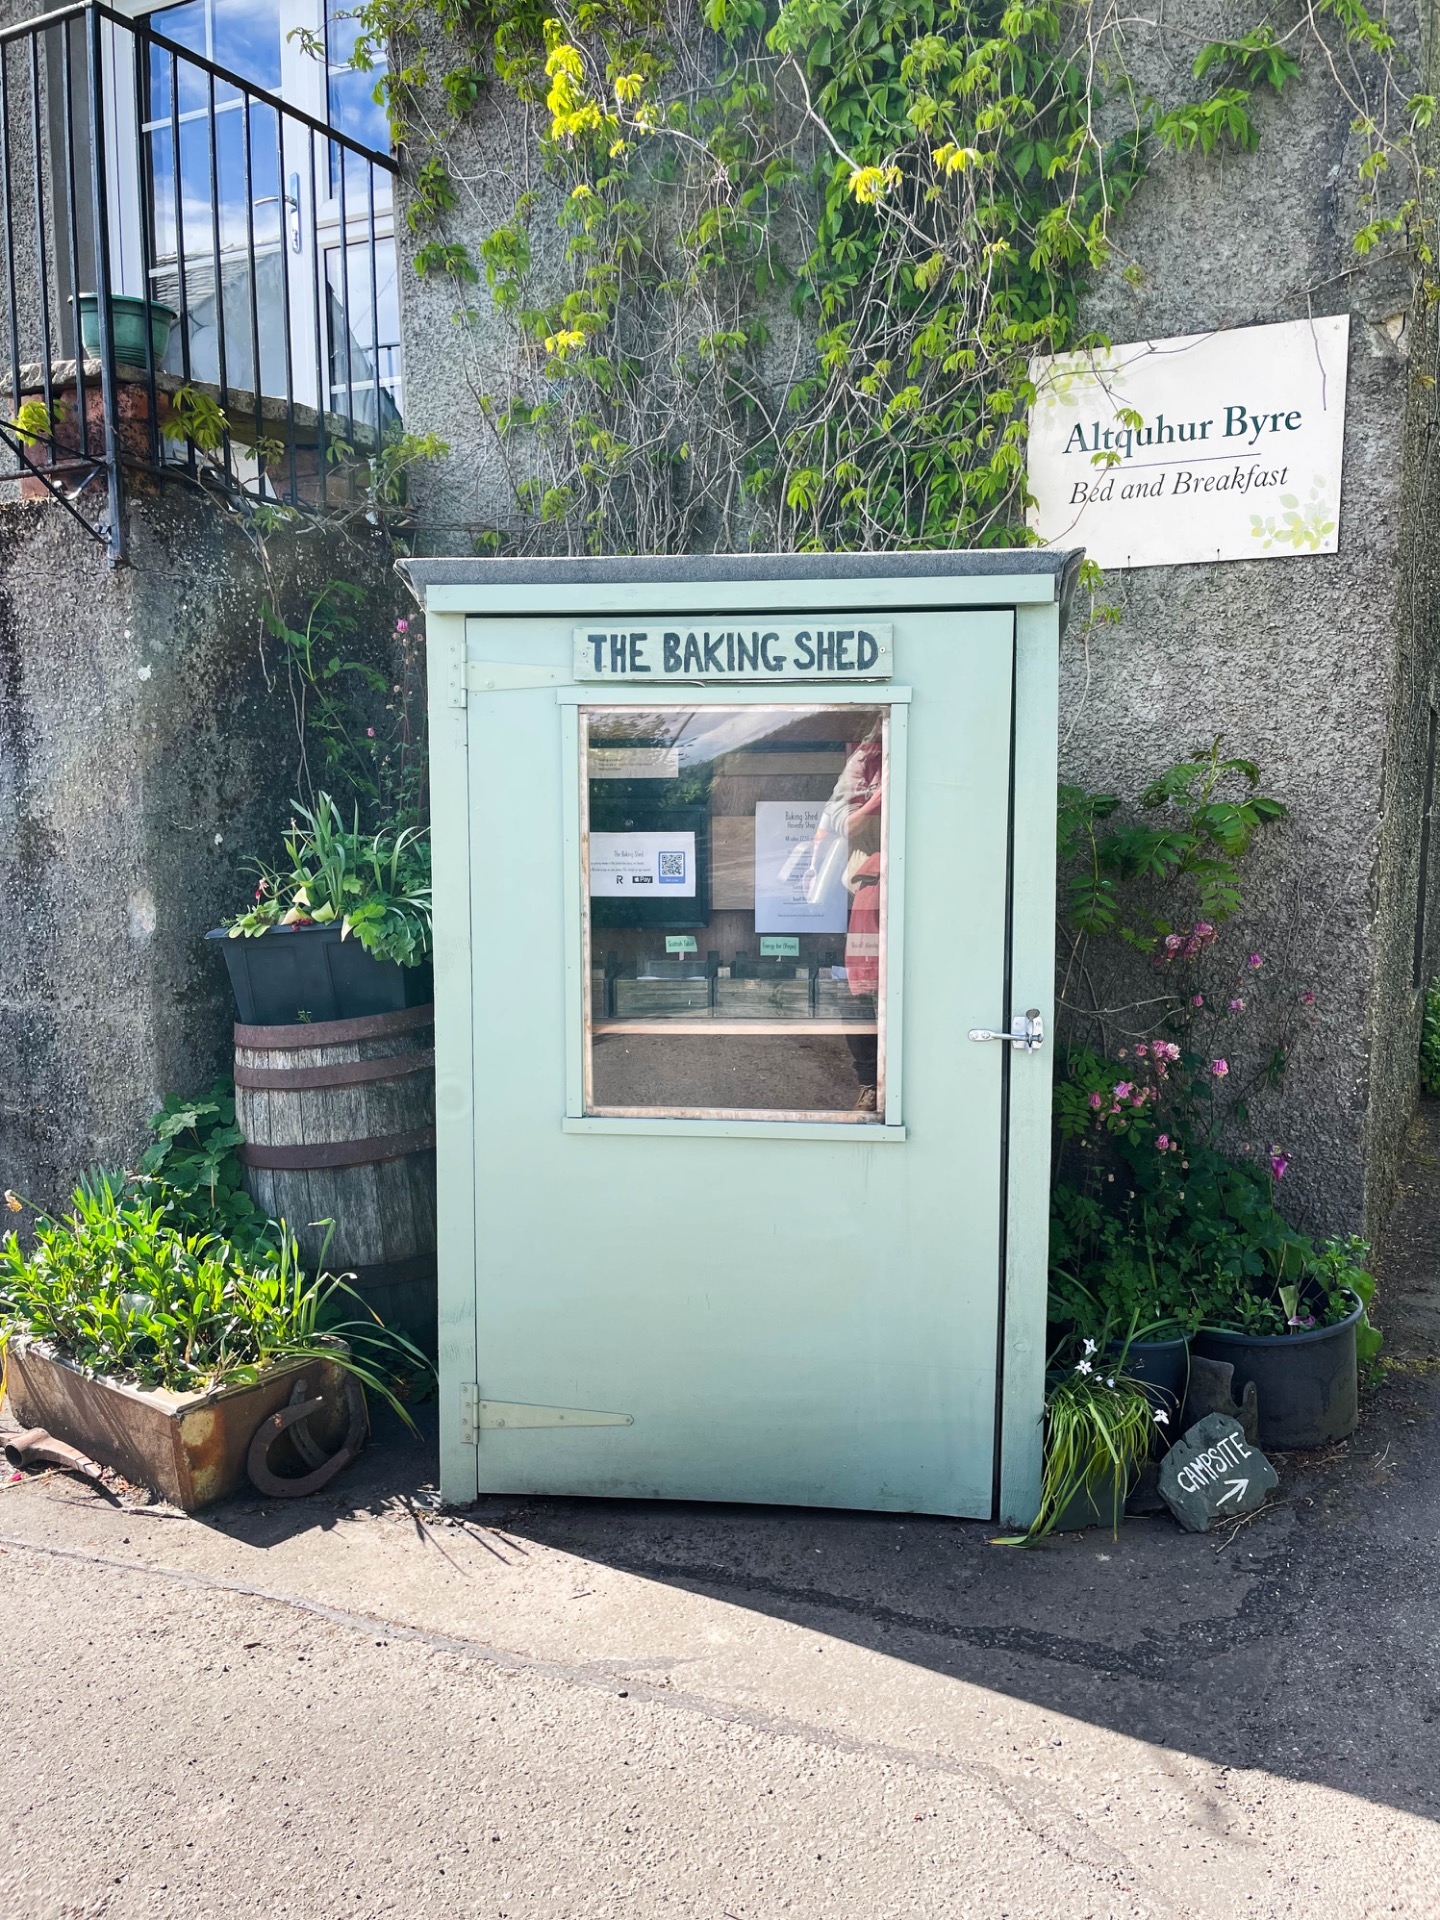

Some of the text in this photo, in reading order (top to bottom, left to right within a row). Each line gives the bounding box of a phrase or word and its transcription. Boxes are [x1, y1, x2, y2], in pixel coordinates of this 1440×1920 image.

[1062, 405, 1302, 458] Altquhur Byre
[1069, 464, 1289, 505] Bed and Breakfast
[587, 630, 879, 673] THE BAKING SHED
[785, 810, 819, 824] Baking Shed
[804, 821, 816, 830] Shop
[1177, 1431, 1252, 1493] CAMPSITE
